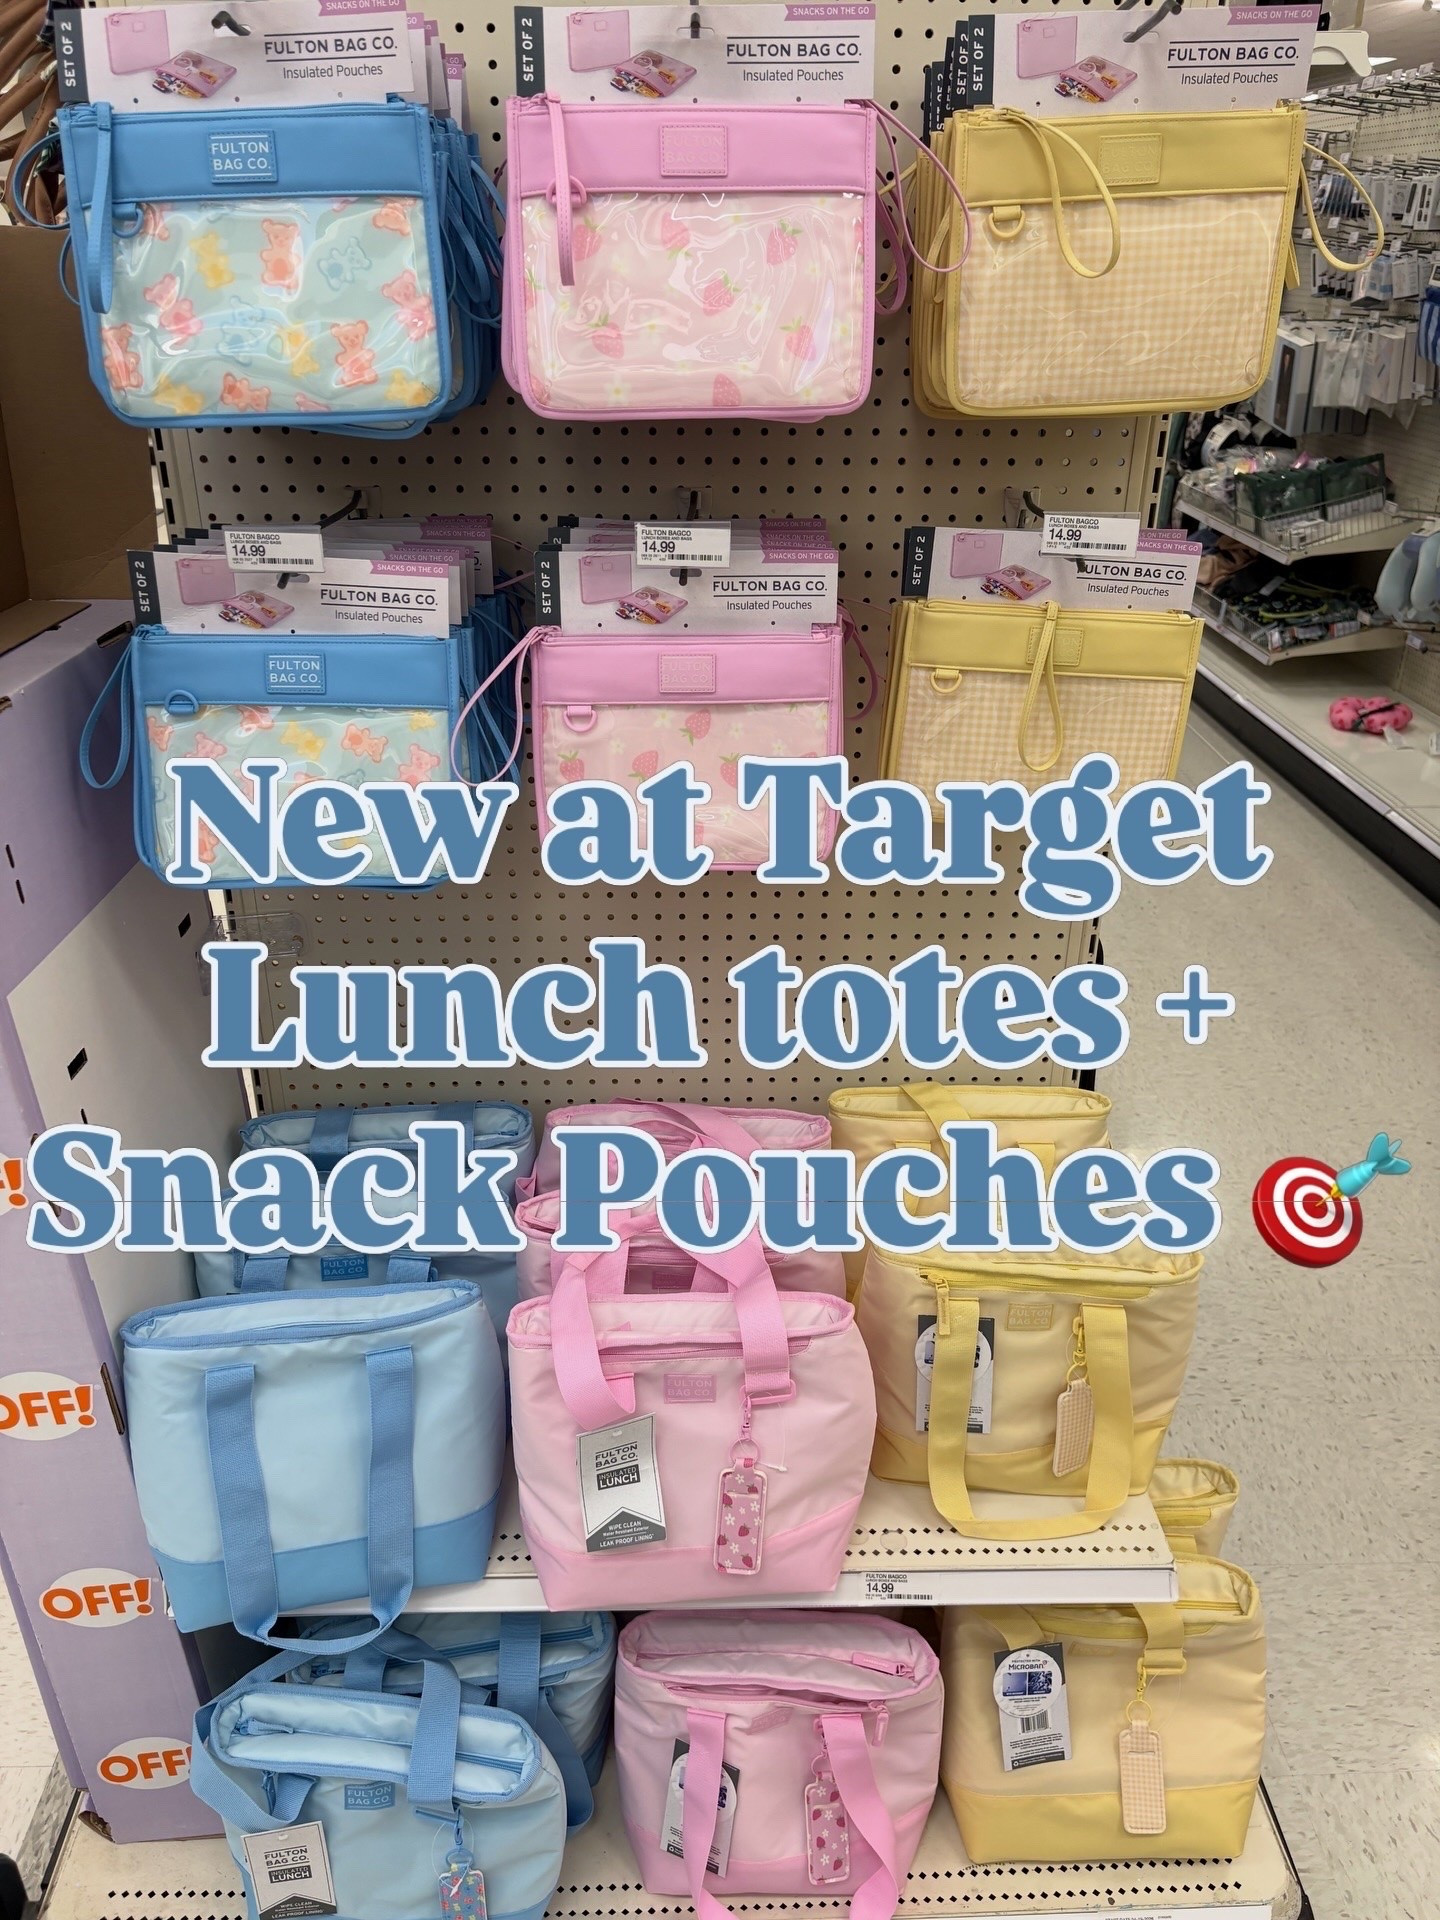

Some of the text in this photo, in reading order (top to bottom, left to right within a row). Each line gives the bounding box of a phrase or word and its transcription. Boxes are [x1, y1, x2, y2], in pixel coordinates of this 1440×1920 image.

[327, 0, 356, 10] SNACKS
[793, 6, 869, 16] SNACKS ON THE GO
[1236, 9, 1312, 20] SNACKS ON THE GO
[264, 36, 397, 55] FULTON BAG CO.
[522, 17, 534, 82] SET OF 2
[726, 43, 862, 58] FULTON BAG CO.
[61, 21, 76, 87] SET OF 2
[959, 47, 968, 64] OF
[973, 28, 984, 91] SET OF 2
[1167, 45, 1299, 62] FULTON BAG CO.
[283, 63, 383, 79] Insulated Pouches
[743, 68, 844, 82] Insulated Pouches
[957, 69, 967, 95] SET
[1181, 71, 1278, 85] Insulated Pouches
[211, 141, 269, 155] FULTON
[213, 158, 271, 171] BAG CO.
[1049, 529, 1081, 540] 14.99
[232, 545, 266, 556] 14.99
[643, 541, 675, 552] 14.99
[914, 545, 924, 561] OF
[912, 562, 922, 585] SET
[1134, 568, 1161, 578] BAG
[1166, 570, 1186, 580] CO.
[134, 560, 151, 612] SET OF 2
[541, 561, 551, 614] SET OF 2
[713, 580, 827, 592] FULTON BAG CO.
[1088, 584, 1169, 596] Insulated Pouches
[320, 589, 438, 606] FULTON BAG CO.
[727, 601, 812, 611] Insulated Pouches
[335, 610, 423, 624] Insulated Pouches
[269, 660, 320, 670] FULTON
[270, 673, 321, 683] BAG CO.
[323, 1259, 364, 1267] FULTON
[667, 1379, 712, 1387] FULTON
[668, 1388, 690, 1397] BAG
[596, 1444, 637, 1461] FULTON
[596, 1452, 638, 1468] BAG CO.
[599, 1467, 637, 1480] INSULATED
[600, 1472, 637, 1488] LUNCH
[867, 1583, 894, 1593] 14.99
[41, 1579, 154, 1619] OFF!
[347, 1785, 392, 1797] FULTON
[348, 1797, 371, 1805] BAG
[265, 1848, 307, 1860] FULTON
[266, 1858, 288, 1866] BAG
[272, 1871, 309, 1881] LUNCH
